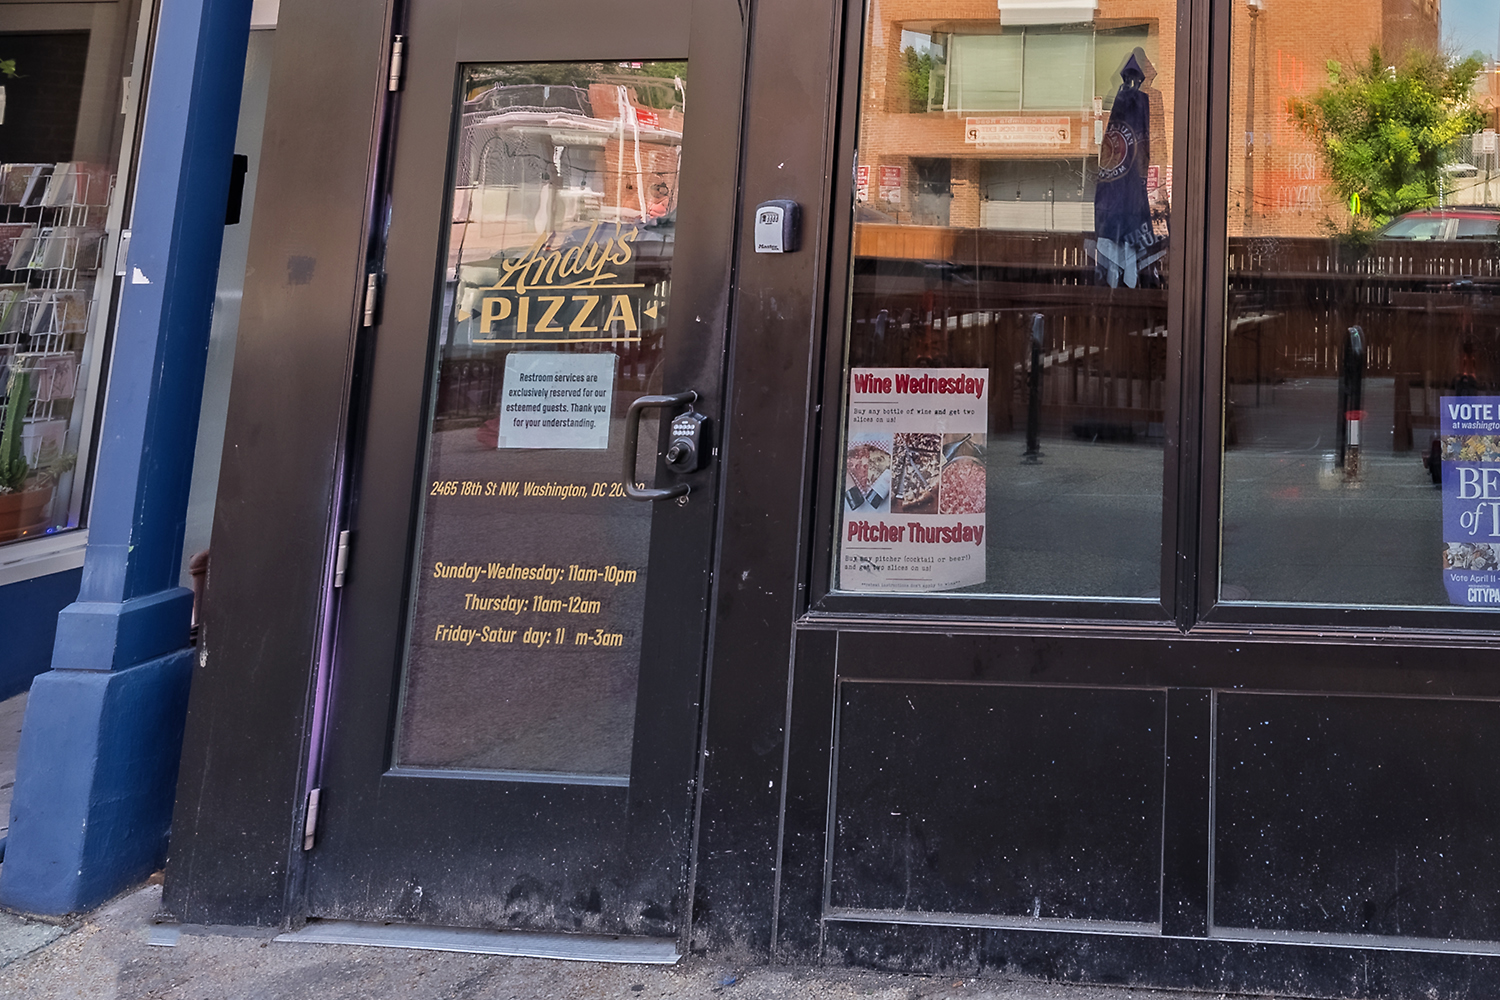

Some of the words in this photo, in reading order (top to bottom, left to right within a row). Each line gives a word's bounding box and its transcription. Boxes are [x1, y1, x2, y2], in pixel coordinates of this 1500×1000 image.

[492, 219, 639, 293] Andy's
[479, 294, 638, 334] PIZZA
[519, 373, 554, 382] Restroom
[554, 373, 585, 382] services
[586, 374, 598, 382] are
[854, 373, 892, 394] Wine
[895, 373, 984, 400] Wednesday
[508, 388, 549, 399] exclusively
[550, 388, 581, 397] reserved
[582, 388, 593, 397] for
[595, 389, 606, 397] our
[506, 403, 541, 412] esteemed
[542, 403, 569, 414] guests.
[571, 403, 592, 412] Thank
[593, 405, 606, 414] you
[1448, 404, 1493, 420] VOTE
[513, 418, 524, 427] for
[525, 419, 541, 429] your
[542, 418, 597, 429] understanding.
[430, 481, 459, 496] 2465
[461, 481, 482, 496] 18th
[485, 482, 497, 496] St
[499, 482, 520, 498] NW,
[523, 482, 588, 500] Washington,
[591, 482, 607, 497] DC
[1460, 502, 1487, 536] of
[847, 520, 905, 542] Pitcher
[907, 522, 984, 547] Thursday
[904, 555, 935, 563] (cocktail
[433, 562, 564, 585] Sunday-Wednesday:
[568, 564, 637, 586] 11am-10pm
[1450, 574, 1468, 582] Vote
[1470, 574, 1488, 583] April
[464, 594, 529, 615] Thursday:
[533, 595, 601, 614] 11am-12am
